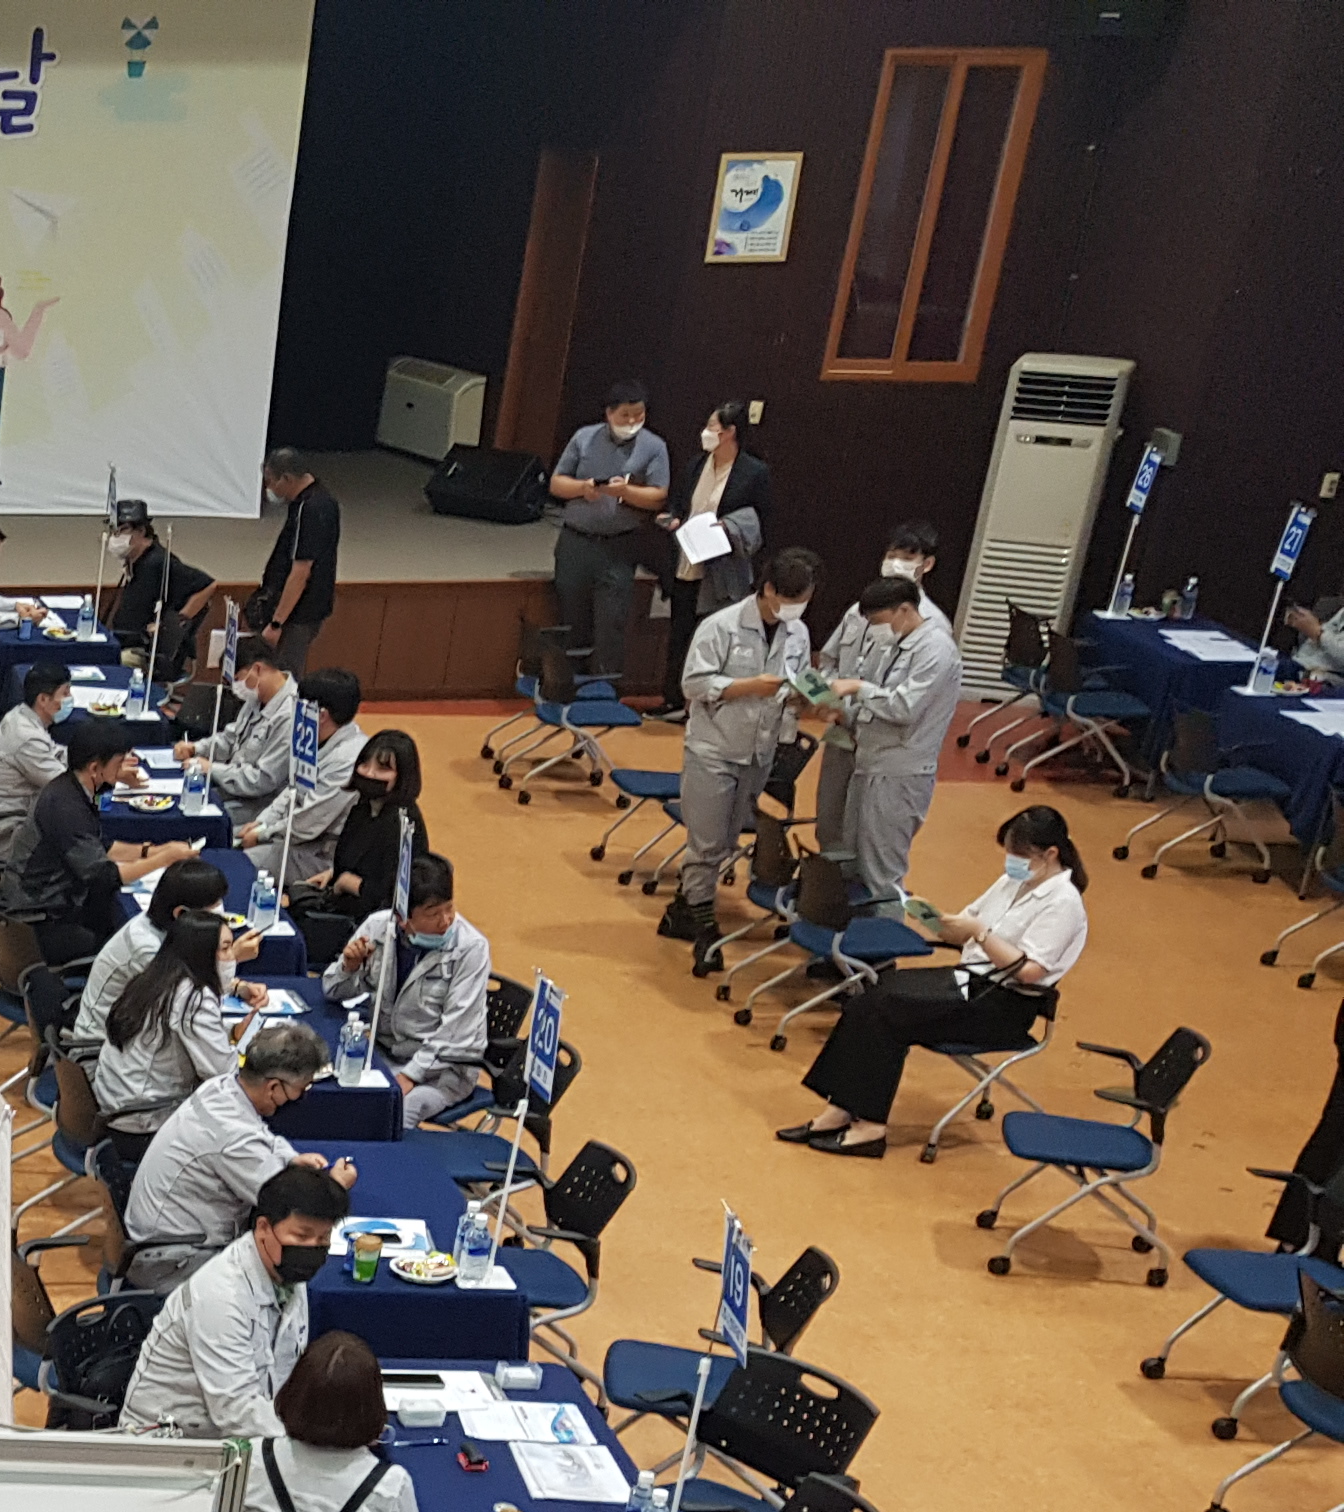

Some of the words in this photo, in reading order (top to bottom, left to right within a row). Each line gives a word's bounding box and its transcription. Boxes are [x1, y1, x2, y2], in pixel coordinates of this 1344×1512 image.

[294, 722, 315, 758] 22
[537, 1011, 554, 1058] 20
[728, 1254, 745, 1309] 19
